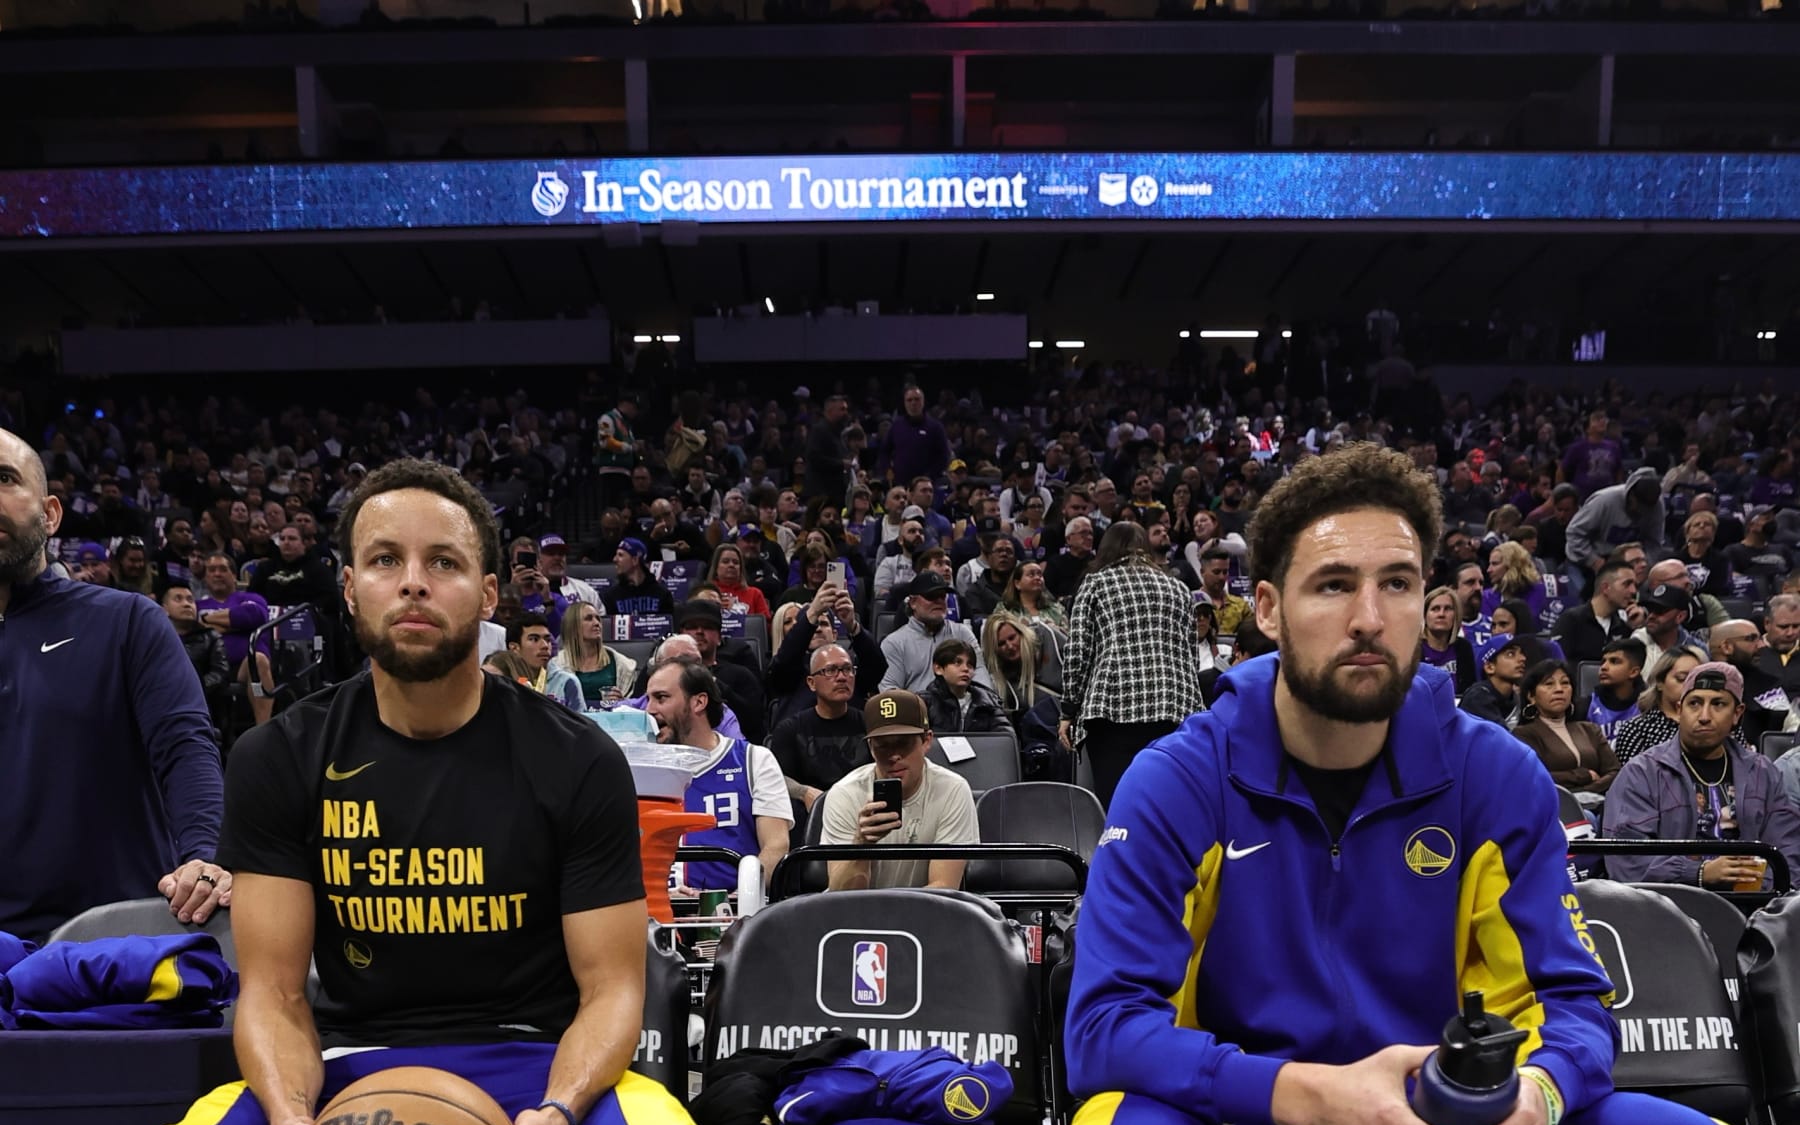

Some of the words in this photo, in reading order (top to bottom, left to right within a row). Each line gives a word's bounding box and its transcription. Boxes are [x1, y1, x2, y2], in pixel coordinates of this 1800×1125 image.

[582, 169, 773, 213] In-Season
[780, 167, 1028, 210] Tournament
[1164, 182, 1213, 196] Rewards
[880, 697, 897, 718] SD
[323, 799, 381, 839] NBA
[703, 792, 739, 828] 13
[321, 847, 485, 886] IN-SEASON
[327, 892, 528, 934] TOURNAMENT
[857, 989, 874, 1001] NBA
[898, 1029, 922, 1052] IN
[927, 1030, 970, 1063] THE
[974, 1032, 1021, 1068] APP.
[1620, 1018, 1646, 1053] IN
[1647, 1017, 1692, 1052] THE
[1695, 1016, 1739, 1051] APP.
